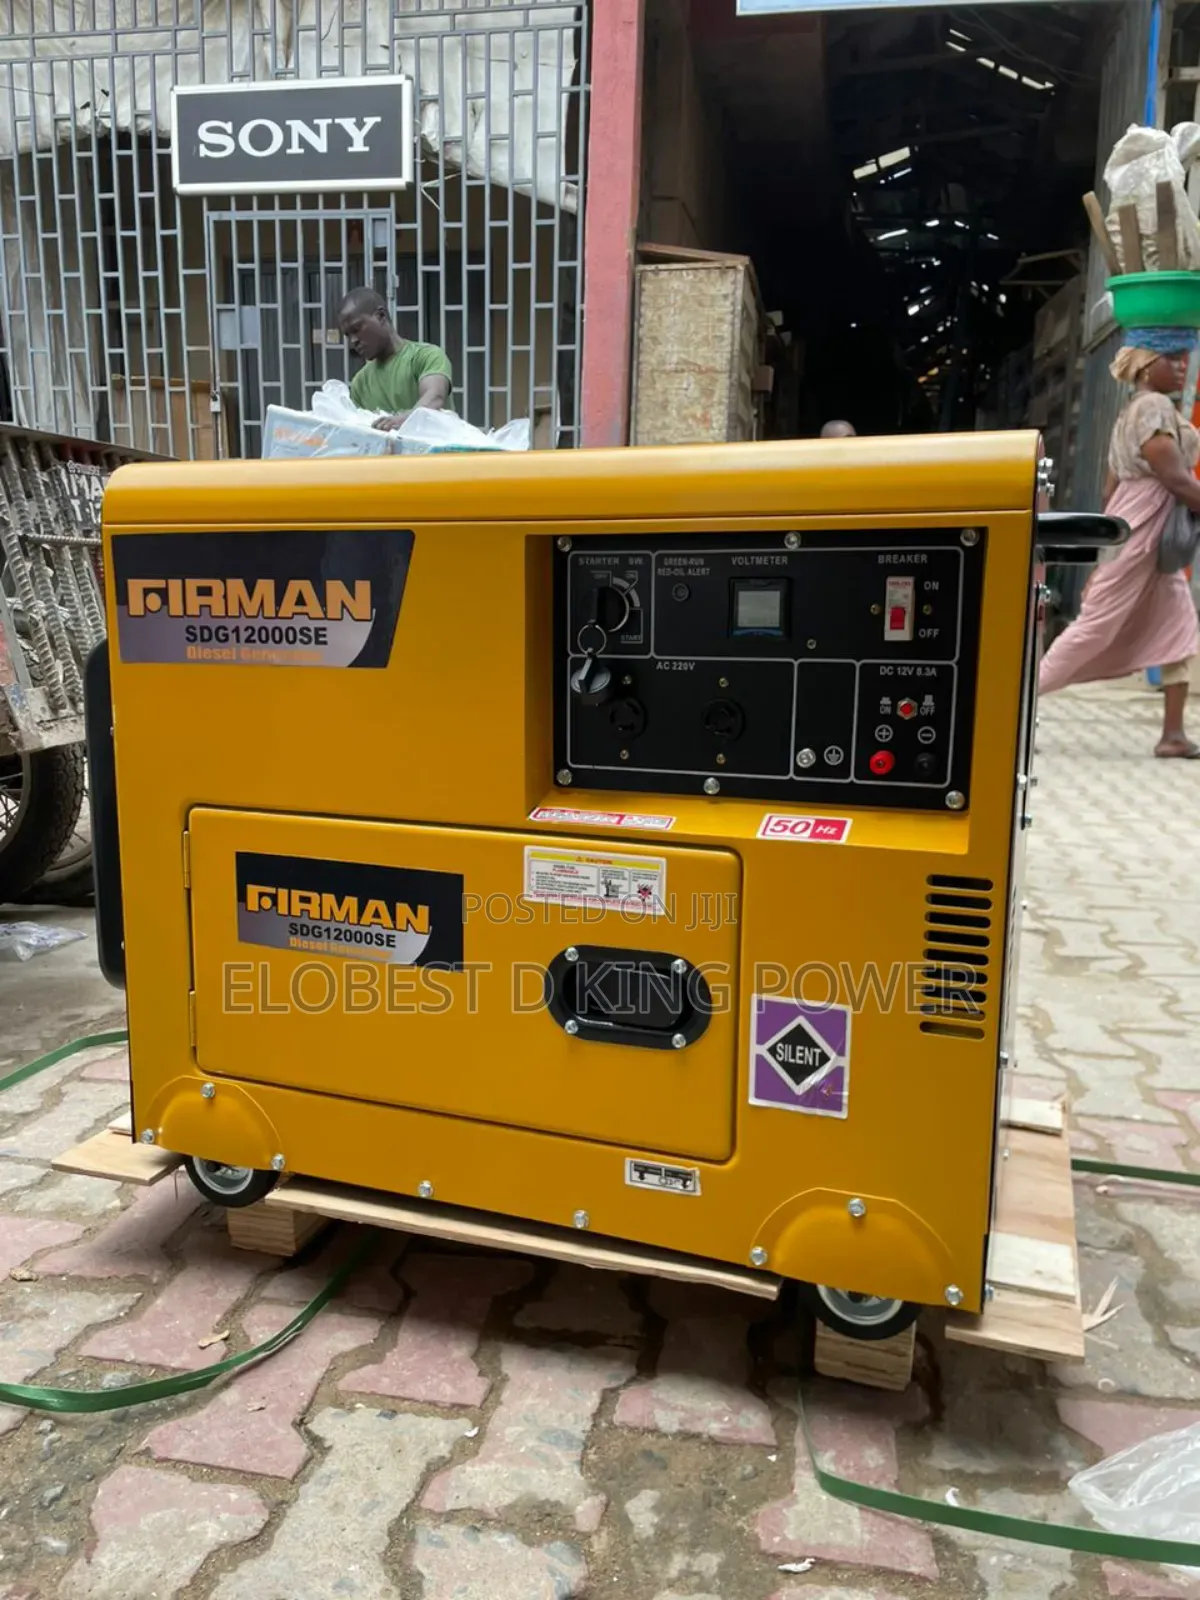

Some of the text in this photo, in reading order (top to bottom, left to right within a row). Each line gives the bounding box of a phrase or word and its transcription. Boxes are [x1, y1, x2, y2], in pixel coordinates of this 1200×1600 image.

[197, 116, 382, 158] SONY
[578, 556, 620, 566] STARTER
[731, 555, 788, 566] VOLTMETER
[878, 553, 928, 565] BREAKER
[687, 567, 711, 576] ALERT
[923, 580, 940, 591] ON
[127, 578, 372, 621] FIRMAN
[185, 624, 329, 646] SDG12000SE
[918, 628, 940, 639] OFF
[186, 645, 237, 661] Diesel
[655, 661, 696, 671] AC 220V
[879, 665, 895, 676] DC
[897, 666, 914, 676] 12V
[880, 705, 892, 715] ON
[919, 706, 936, 717] OFF
[769, 819, 812, 835] 50
[245, 884, 430, 935] FIRMAN
[288, 922, 397, 949] SDG12000SE
[775, 1042, 822, 1067] SILENT
